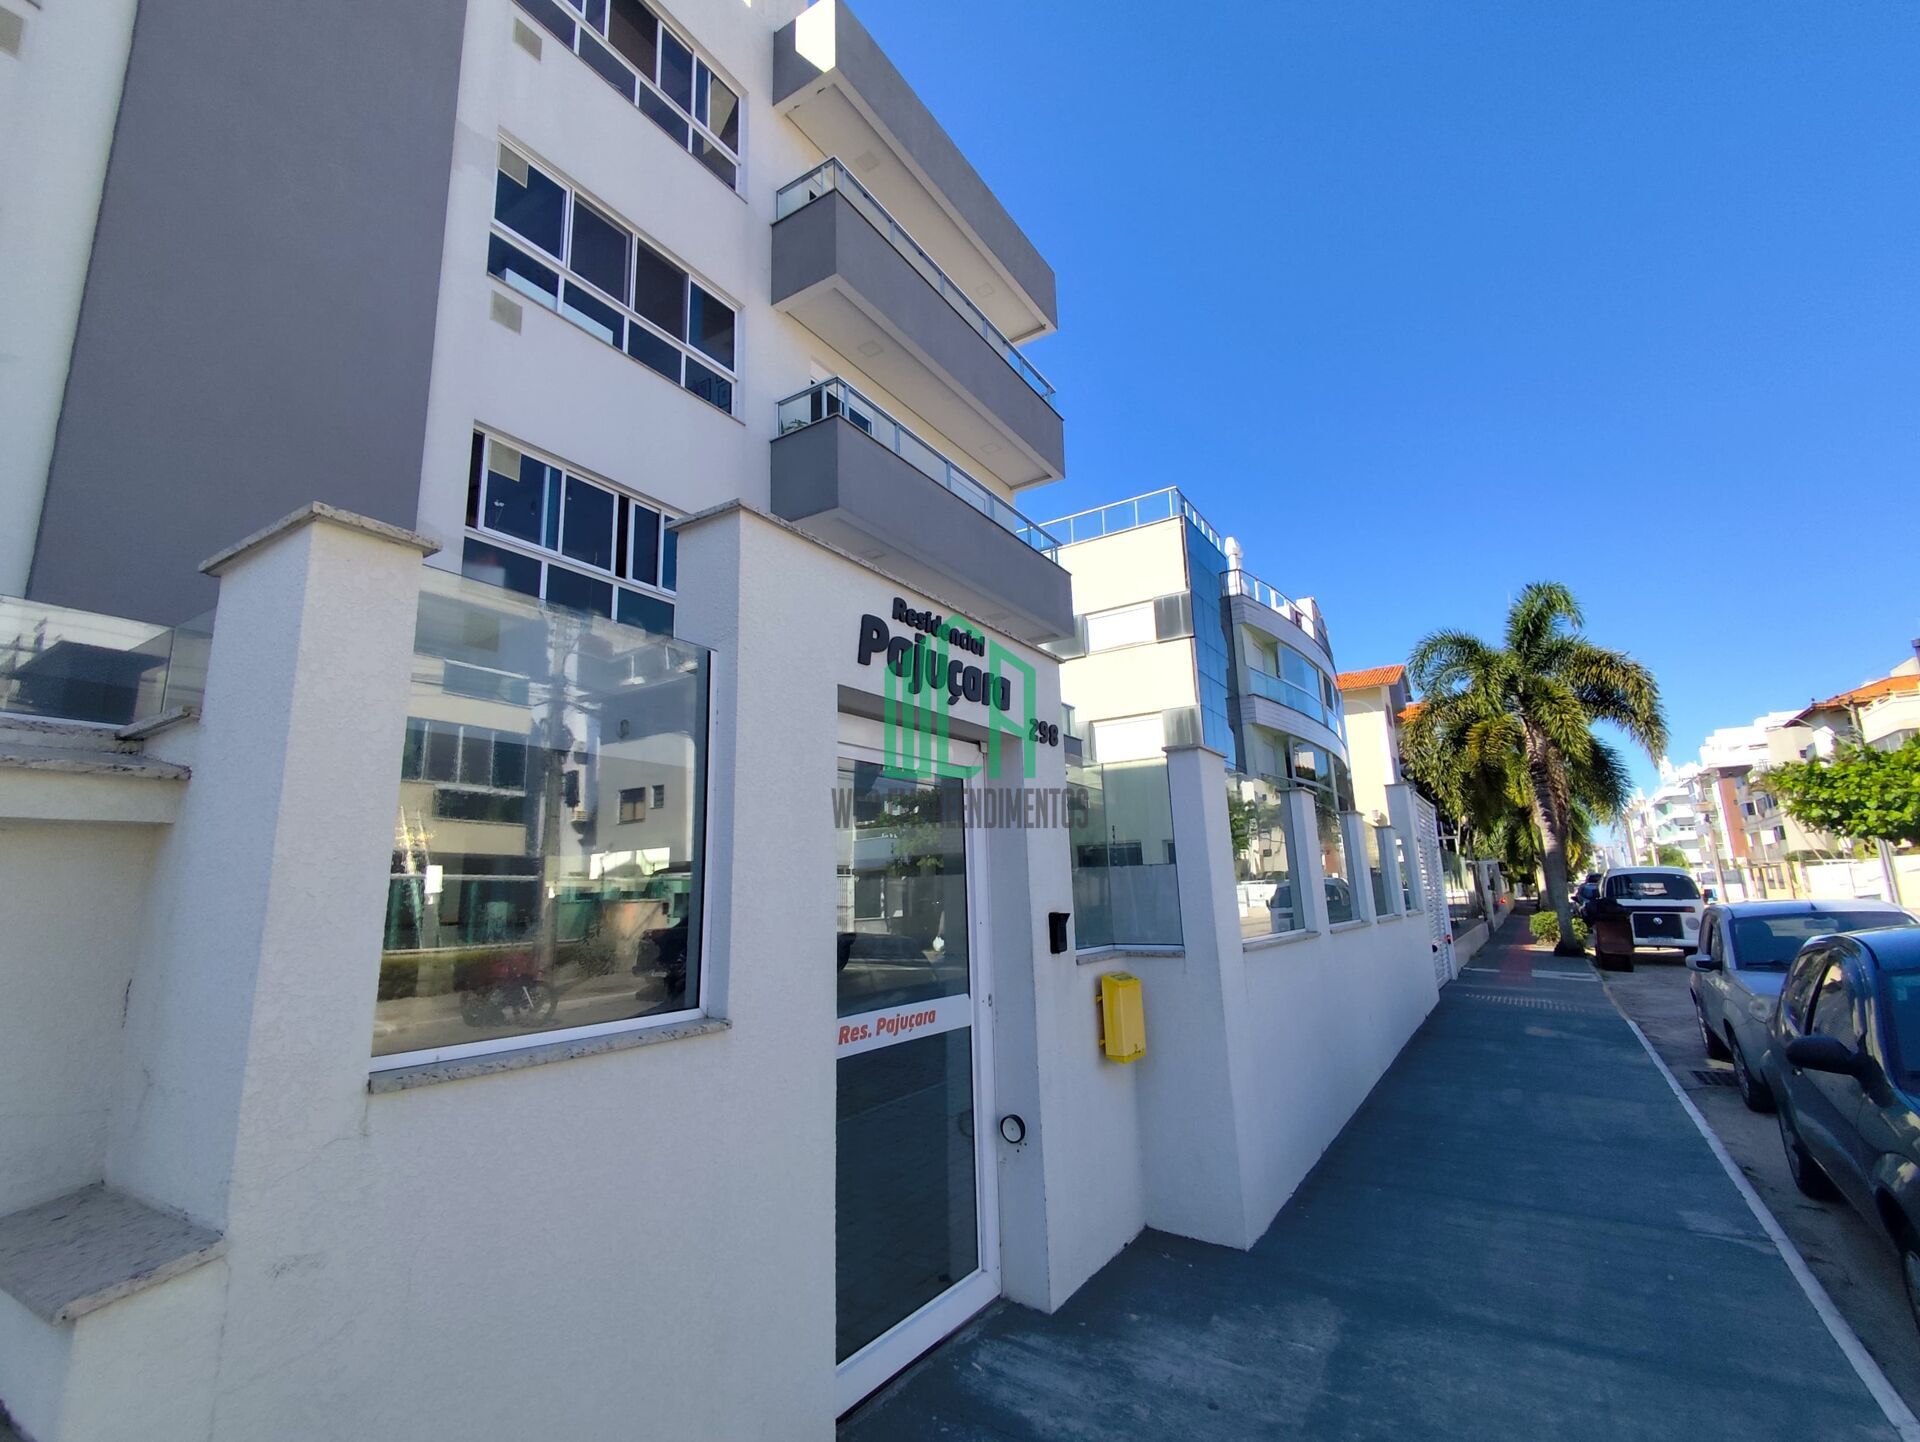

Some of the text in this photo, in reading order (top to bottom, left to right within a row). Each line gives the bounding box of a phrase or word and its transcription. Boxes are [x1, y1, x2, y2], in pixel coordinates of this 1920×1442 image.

[891, 597, 985, 657] Residencial
[857, 613, 1011, 711] Pajuçara
[1029, 718, 1059, 747] 298
[838, 1009, 936, 1045] Res. Pajuçara
